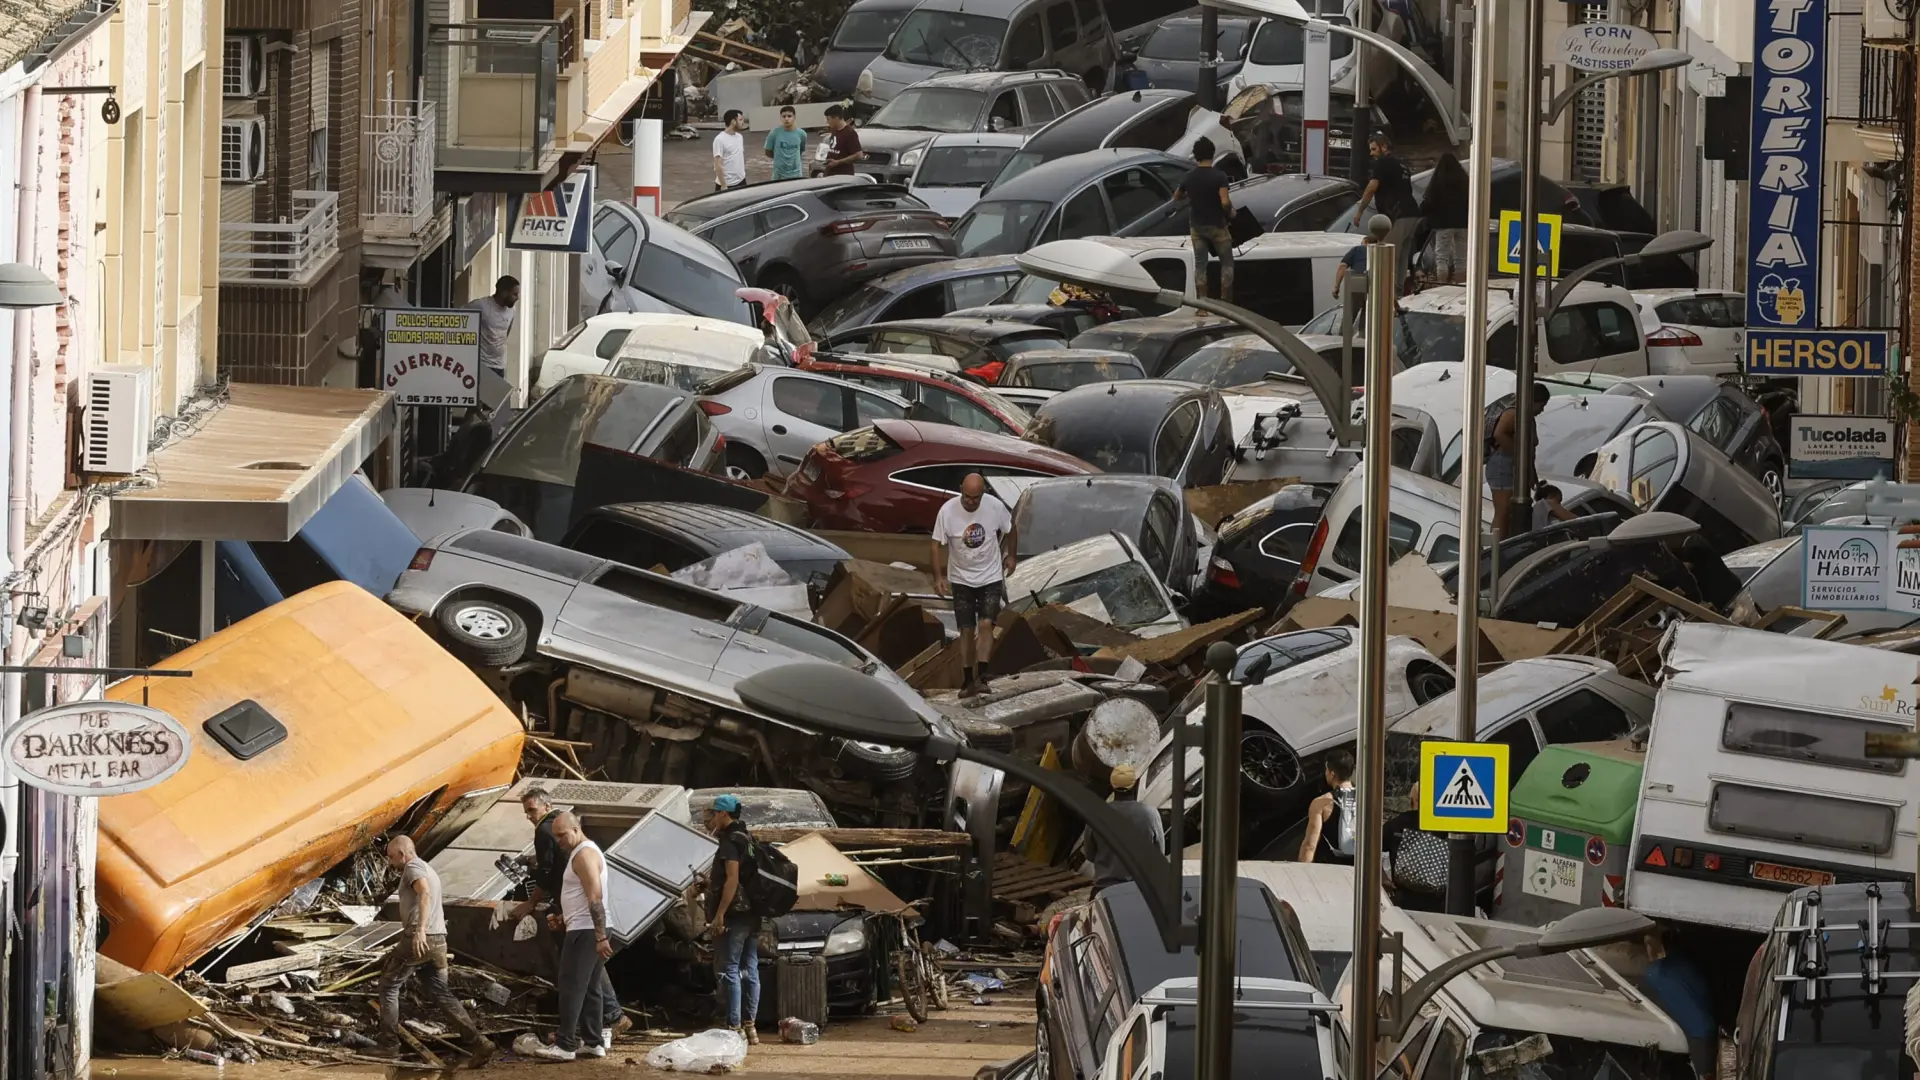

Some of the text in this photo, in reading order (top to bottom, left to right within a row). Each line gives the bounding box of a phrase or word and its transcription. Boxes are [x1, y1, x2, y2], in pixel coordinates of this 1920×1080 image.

[1584, 26, 1632, 40] FORN
[1565, 37, 1647, 56] La Carretera
[1570, 54, 1637, 69] PASTISSERI
[1756, 0, 1814, 269] TORERIA
[521, 218, 566, 231] FIATC
[396, 314, 469, 328] POLLOS ASADOS Y
[387, 330, 477, 345] COMIDAS PARA LLEVAR
[1751, 338, 1882, 370] HERSOL
[386, 352, 475, 389] GUERRERO
[1798, 426, 1887, 442] Tucolada
[1811, 545, 1850, 560] INMO
[1817, 561, 1880, 576] HÁBITAT
[1897, 561, 1920, 590] INM
[1859, 695, 1889, 712] Sun
[80, 712, 110, 729] PUB
[23, 729, 170, 759] DARKNESS
[48, 760, 142, 780] METAL BAR
[1552, 858, 1576, 868] ALFAFAR
[1560, 877, 1576, 888] TOTS
